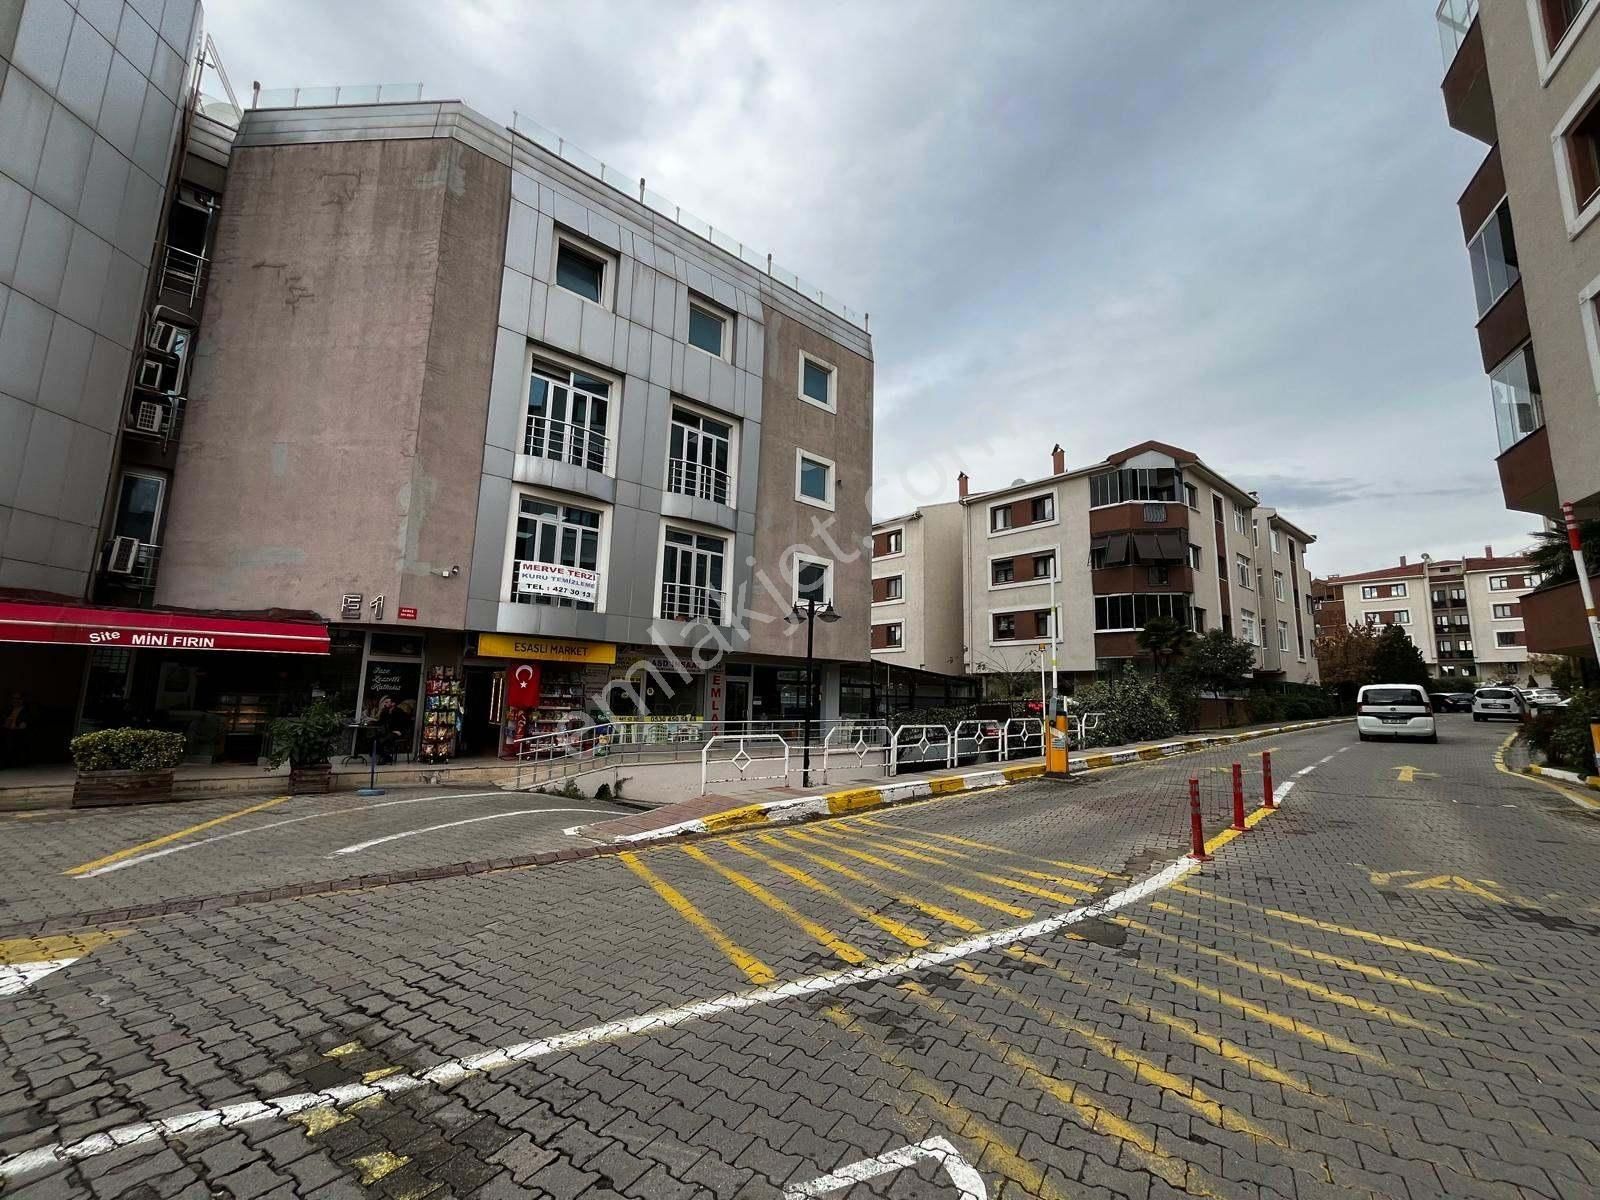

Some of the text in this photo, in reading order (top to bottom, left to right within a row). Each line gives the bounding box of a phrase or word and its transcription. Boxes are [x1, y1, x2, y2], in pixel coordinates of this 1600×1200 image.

[523, 563, 565, 574] MERVE
[522, 573, 548, 581] KURU
[526, 583, 544, 591] TEL
[570, 588, 580, 596] 30
[89, 631, 121, 643] Site
[172, 636, 215, 648] FIRIN
[514, 642, 589, 656] ESASLI MARKET
